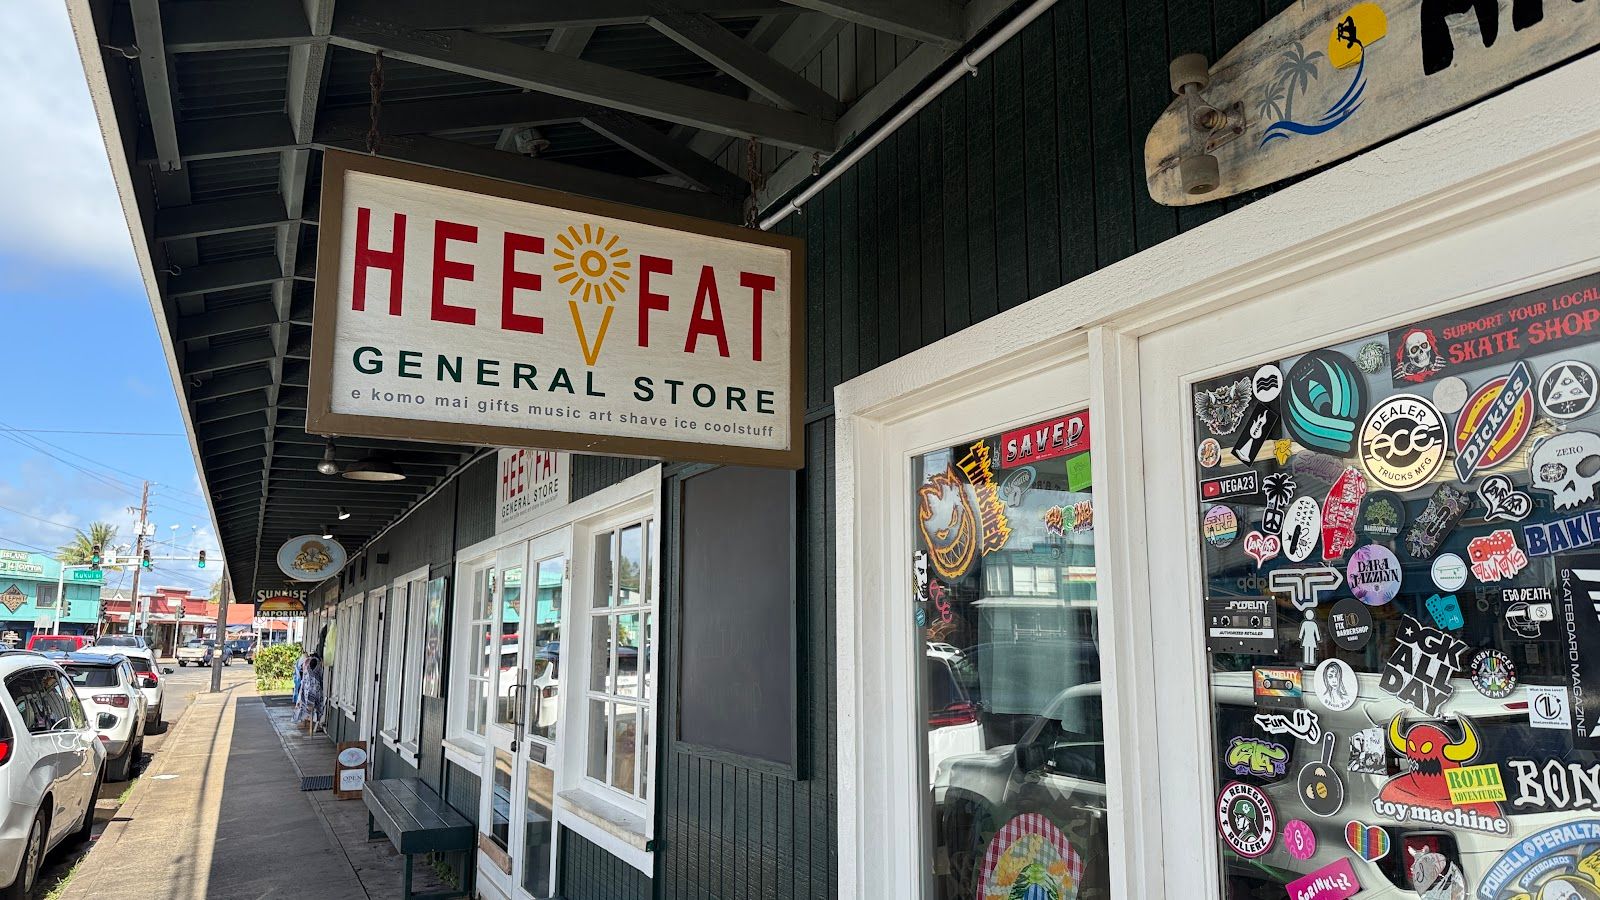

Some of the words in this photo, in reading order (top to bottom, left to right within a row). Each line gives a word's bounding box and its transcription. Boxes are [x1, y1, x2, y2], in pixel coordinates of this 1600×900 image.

[352, 207, 545, 334] HEE
[638, 254, 775, 362] FAT
[1443, 314, 1503, 340] SUPPORT
[1508, 302, 1547, 322] YOUR
[1552, 287, 1600, 311] LOCAL
[1448, 328, 1521, 364] SKATE
[1528, 309, 1600, 345] SHOP
[352, 346, 605, 397] GENERAL
[633, 376, 775, 414] STORE
[351, 388, 361, 399] e
[372, 388, 425, 404] komo
[436, 395, 468, 409] mai
[478, 398, 519, 414] gifts
[529, 404, 581, 419] music
[589, 410, 612, 422] art
[619, 412, 667, 428] shave
[674, 417, 697, 430] ice
[704, 421, 773, 437] coolstuff
[1372, 404, 1426, 431] DEALER
[1462, 377, 1524, 469] Dickies
[1006, 417, 1085, 462] SAVED
[1555, 446, 1584, 457] ZERO
[502, 449, 525, 502] HEE
[1377, 465, 1413, 481] TRUCKS
[1415, 457, 1432, 476] MFG
[501, 494, 530, 518] GENERAL
[533, 479, 559, 502] STORE
[957, 440, 1012, 557] THRASHER
[1220, 476, 1254, 494] VEGA23
[1295, 501, 1305, 522] TOSA
[1301, 501, 1311, 525] SKATE
[1306, 504, 1316, 526] PARK
[1525, 511, 1600, 555] BAKE
[74, 571, 94, 579] Kukui
[1350, 569, 1400, 589] JAZZLYN
[1357, 558, 1390, 572] DARA
[257, 590, 308, 604] SUNRISE
[1502, 589, 1520, 602] EGO
[1520, 588, 1552, 601] DEATH
[1333, 613, 1344, 622] THE
[1335, 622, 1345, 630] FIX
[1336, 625, 1369, 637] BARBERSHOP
[1396, 615, 1468, 669] DGK
[1561, 568, 1579, 662] SKATEBOARD
[1571, 663, 1586, 738] MAGAZINE
[1388, 643, 1453, 695] ALL
[1471, 650, 1490, 669] DERBY
[1492, 650, 1514, 670] LACES
[1379, 665, 1449, 716] DAY
[1471, 675, 1491, 696] Saved
[1504, 676, 1516, 694] Sole
[1448, 767, 1500, 789] ROTH
[1508, 759, 1600, 808] BON
[1229, 785, 1271, 822] RENEGADE
[1453, 789, 1504, 802] ADVENTURES
[1374, 798, 1409, 820] toy
[1410, 805, 1507, 833] machine
[1227, 831, 1267, 853] ROLLERZ
[1481, 850, 1530, 899] POWELL
[1531, 823, 1600, 853] PERALTA
[1521, 856, 1570, 887] SKATEBOARDS
